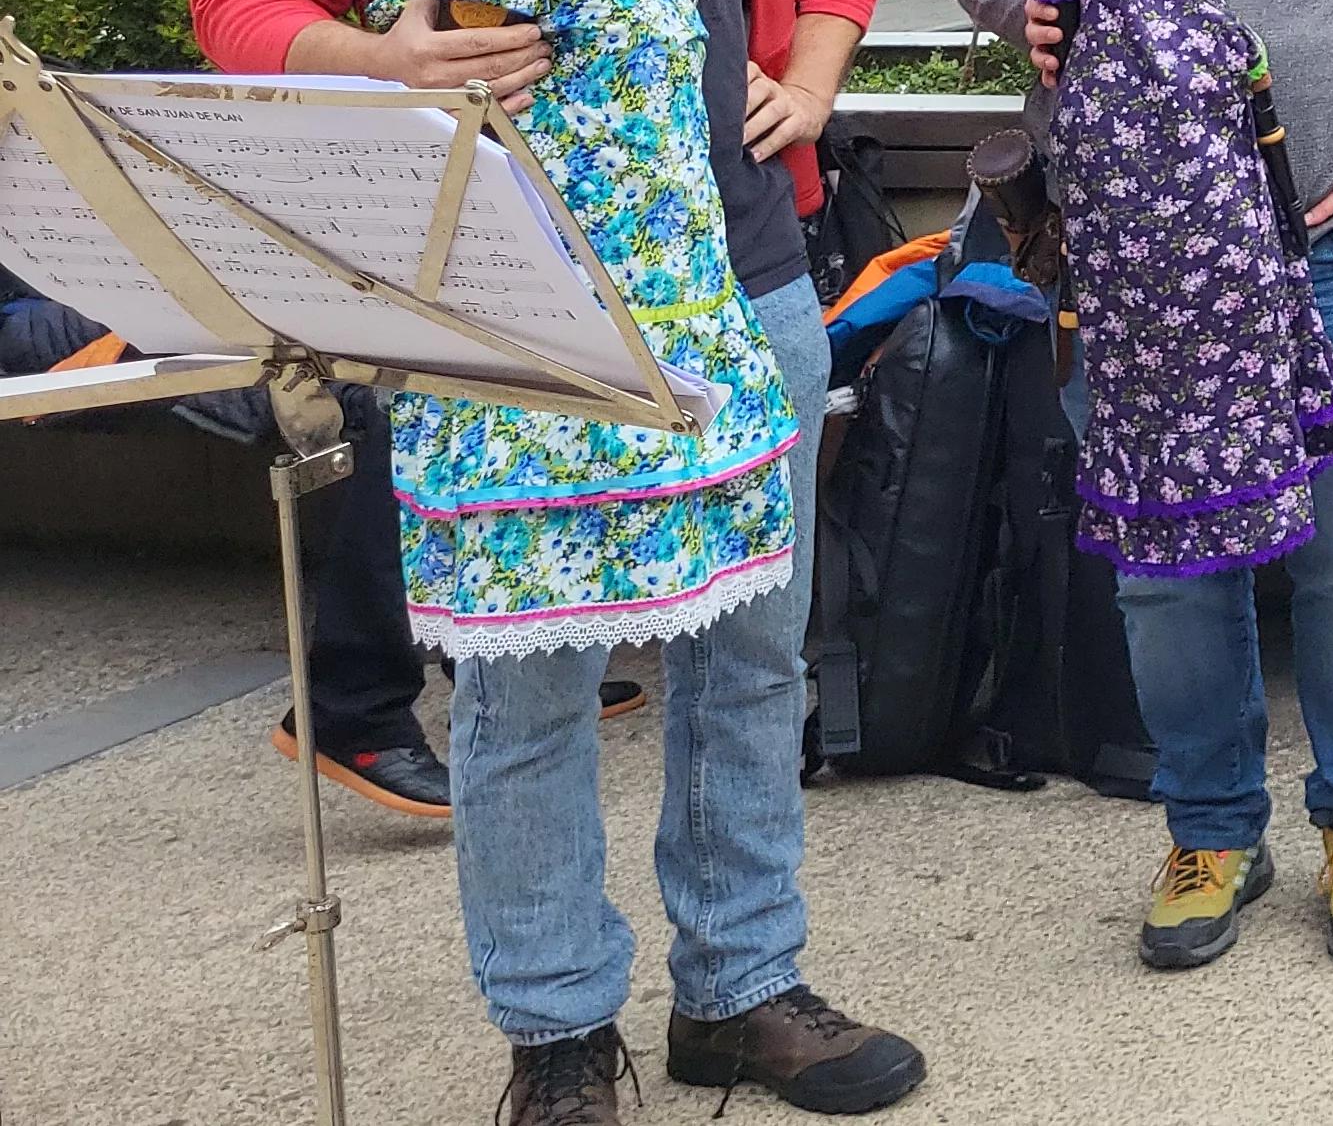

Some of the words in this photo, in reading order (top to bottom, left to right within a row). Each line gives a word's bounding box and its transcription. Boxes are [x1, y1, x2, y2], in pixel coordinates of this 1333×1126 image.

[118, 106, 134, 116] DE
[137, 107, 161, 117] SAN
[163, 109, 195, 119] JUAN
[196, 111, 212, 121] DE
[214, 112, 243, 123] PLAN
